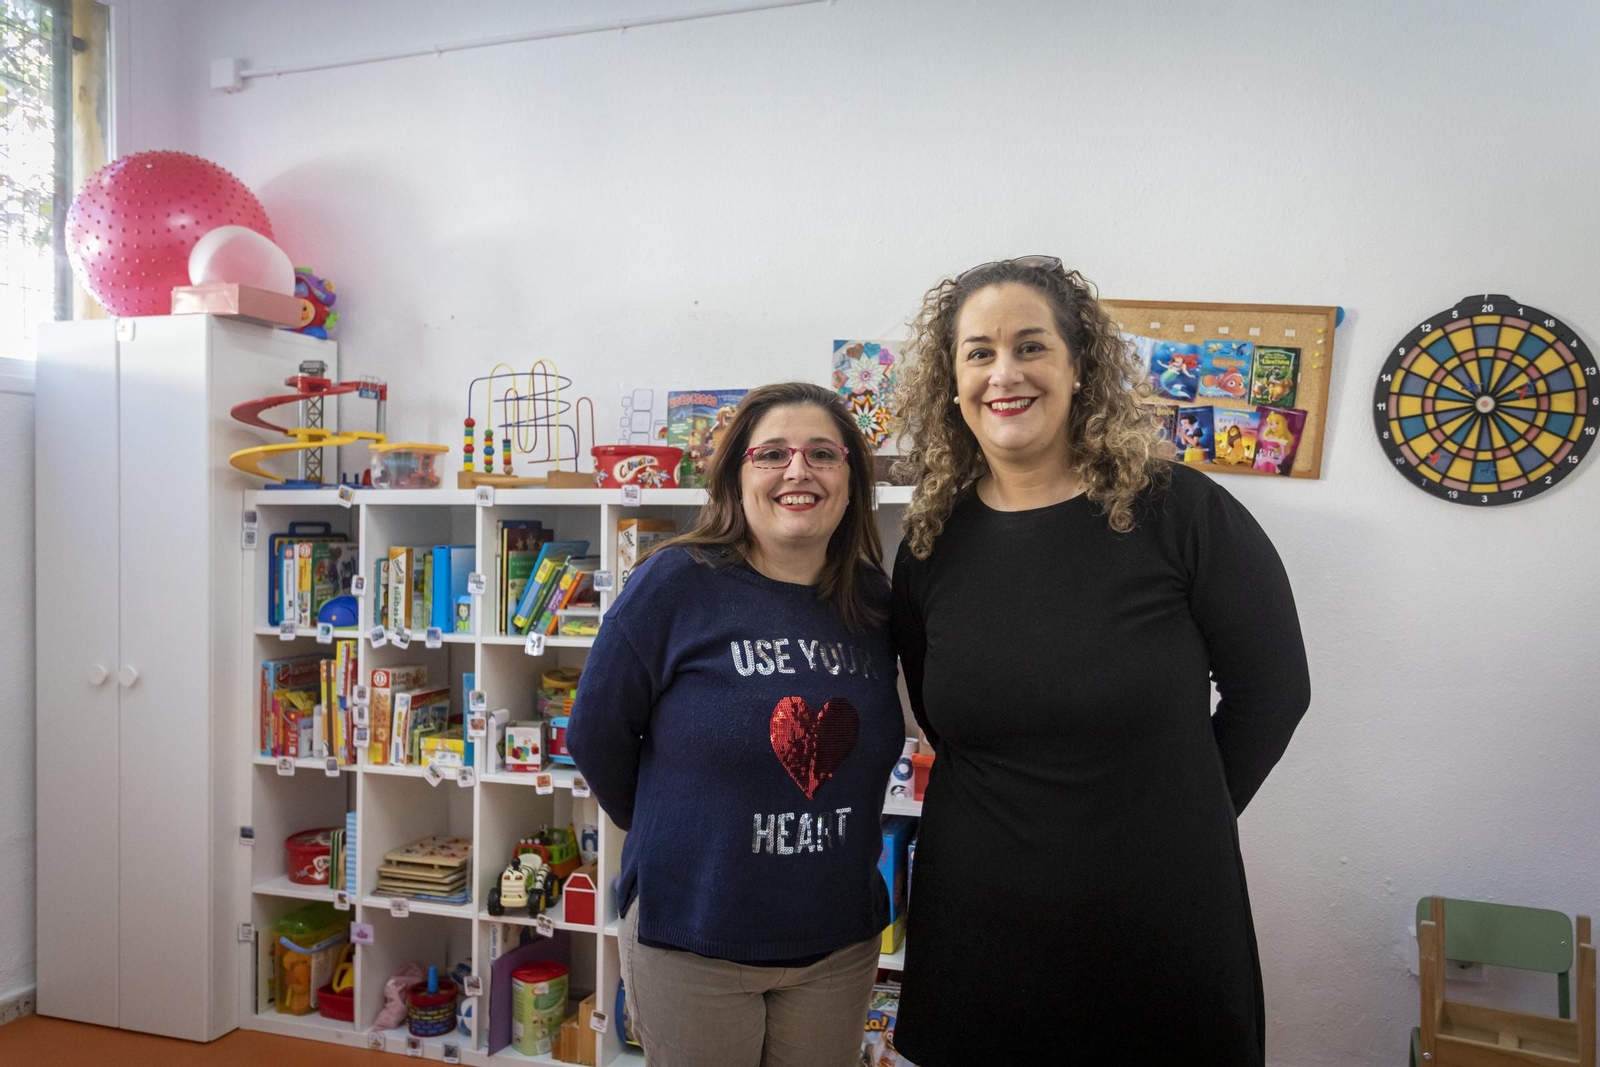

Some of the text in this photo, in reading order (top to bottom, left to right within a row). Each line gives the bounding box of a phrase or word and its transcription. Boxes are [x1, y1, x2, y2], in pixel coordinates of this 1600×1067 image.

[1481, 304, 1494, 313] 20
[1517, 307, 1524, 316] 1
[1452, 310, 1458, 318] 5
[1544, 319, 1556, 328] 18
[1420, 324, 1432, 333] 12
[1570, 340, 1577, 348] 4
[1399, 347, 1405, 356] 9
[1585, 367, 1596, 375] 13
[1381, 374, 1391, 382] 14
[1592, 397, 1599, 405] 6
[1376, 402, 1386, 411] 11
[1383, 431, 1389, 439] 8
[1584, 427, 1595, 435] 10
[1394, 457, 1405, 465] 16
[1567, 455, 1578, 464] 15
[1421, 478, 1428, 487] 7
[1545, 476, 1552, 485] 2
[1447, 490, 1459, 499] 19
[1512, 489, 1523, 499] 17
[1481, 495, 1488, 503] 3
[731, 638, 796, 677] USE
[751, 807, 852, 855] HEART
